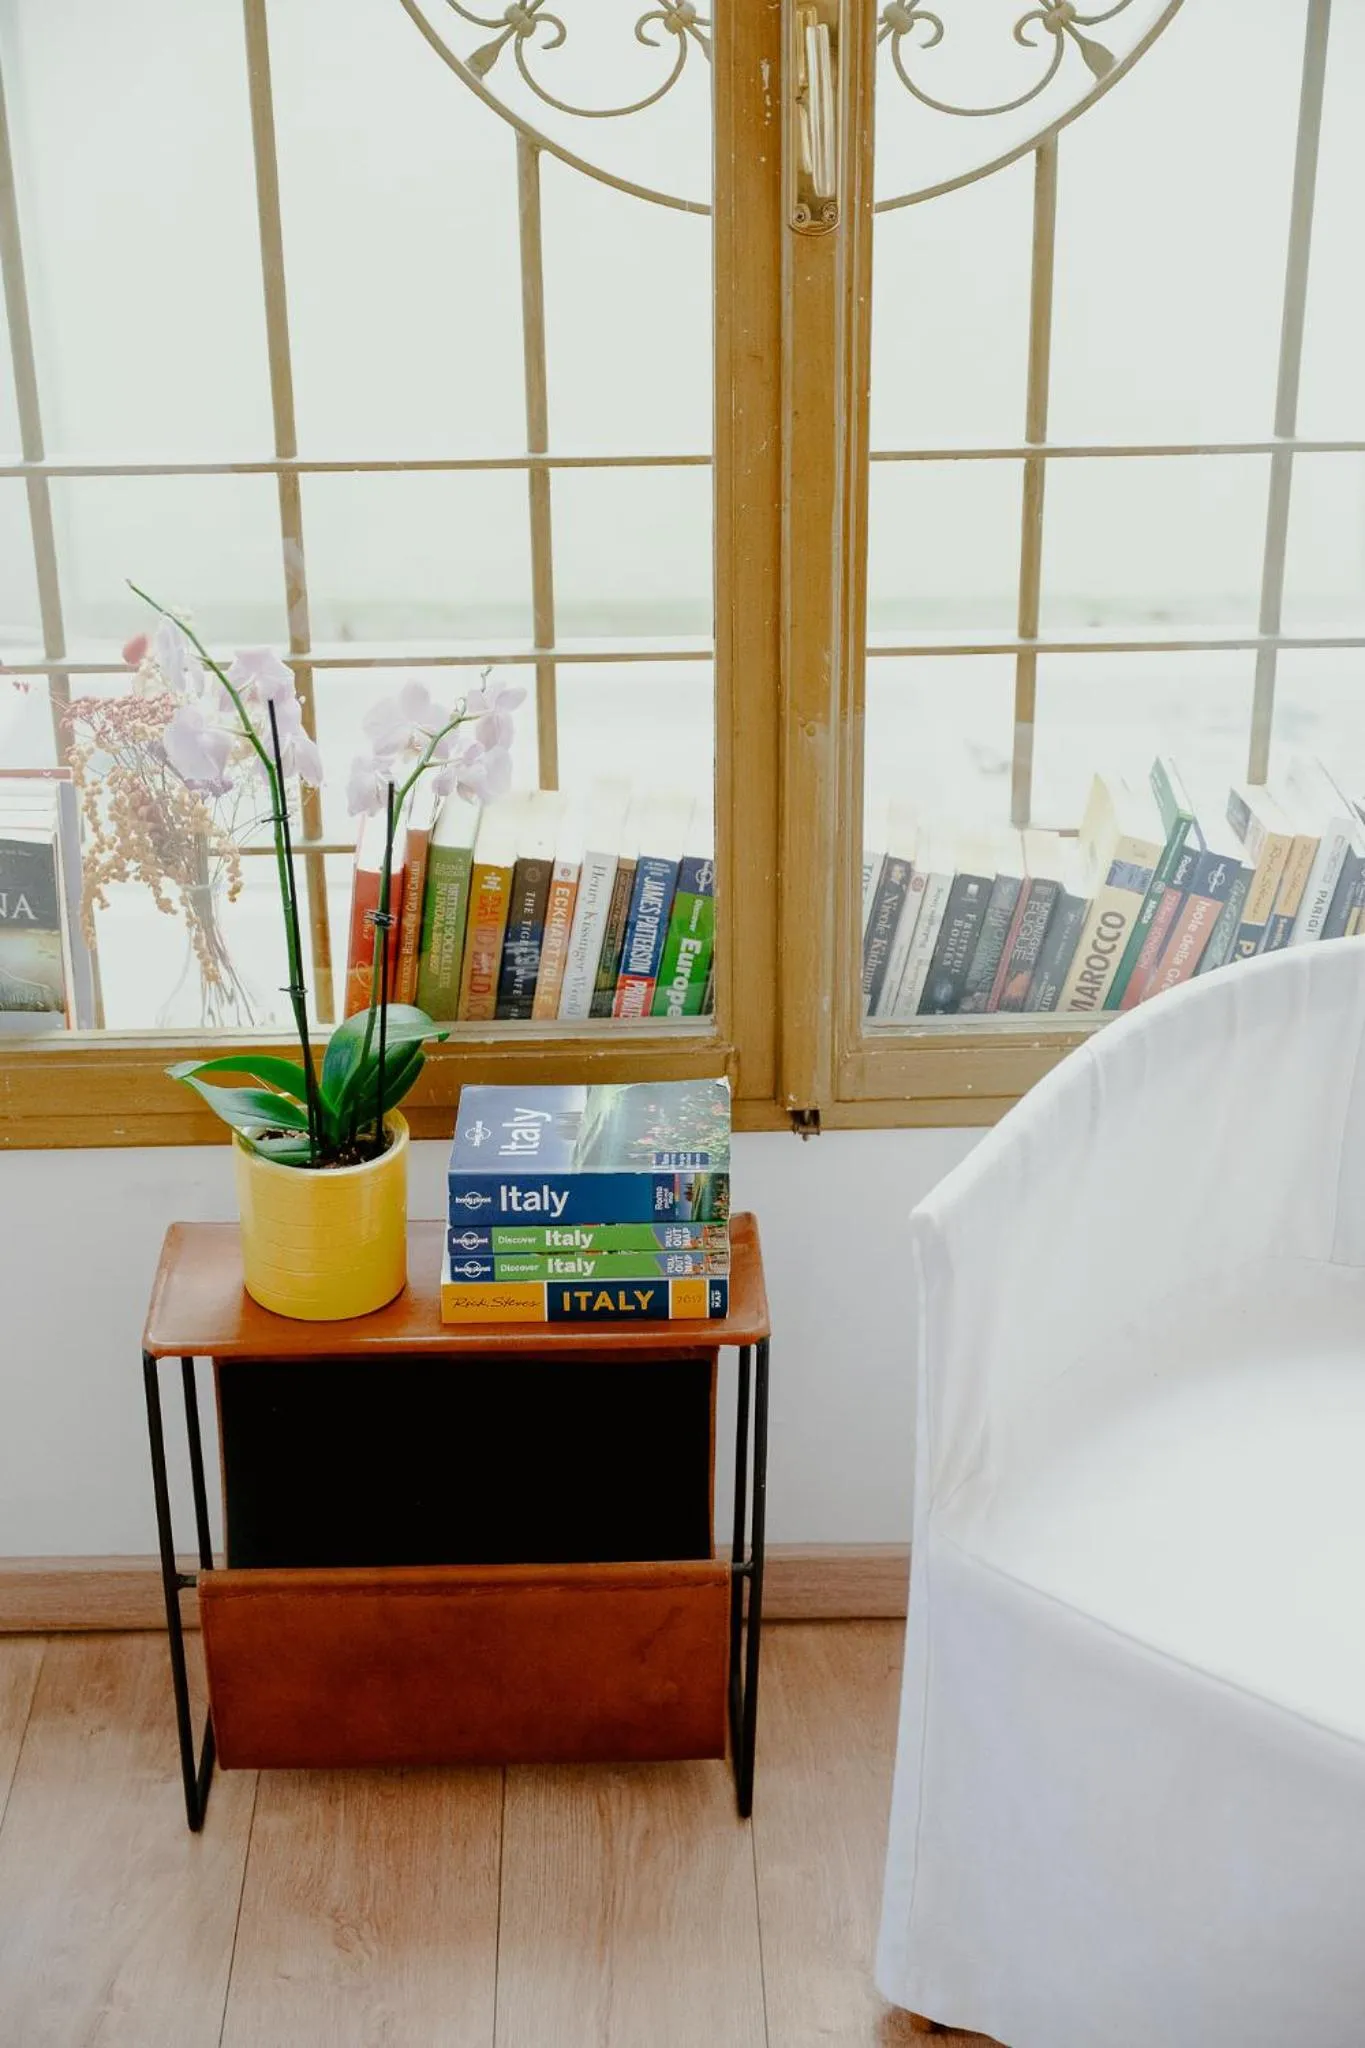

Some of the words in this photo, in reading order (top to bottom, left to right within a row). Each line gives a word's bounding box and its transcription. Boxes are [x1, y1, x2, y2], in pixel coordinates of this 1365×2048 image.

[524, 891, 536, 914] THE
[582, 865, 607, 907] Henry
[639, 877, 666, 914] JAMES
[548, 887, 570, 953] ECKHART
[876, 894, 899, 934] Nicole
[1012, 900, 1036, 961] FUGUE
[1021, 901, 1051, 962] MIDNIGHT
[1187, 900, 1212, 932] Isole
[1305, 889, 1329, 934] PARIGI
[572, 908, 599, 971] Kissinger
[628, 914, 661, 974] PATTERSON
[942, 918, 964, 966] BODIES
[951, 912, 977, 975] FRUITFUL
[1172, 934, 1193, 966] della
[540, 953, 559, 1001] TOLLE
[665, 938, 704, 1017] Europe
[862, 937, 889, 994] Kidman
[567, 973, 587, 1017] World
[498, 1107, 552, 1156] Italy
[500, 1185, 569, 1217] Italy
[497, 1235, 537, 1245] Discover
[545, 1229, 594, 1249] Italy
[673, 1227, 683, 1247] OUT
[500, 1263, 539, 1272] Discover
[547, 1257, 596, 1276] Italy
[675, 1255, 684, 1272] OUT
[563, 1290, 654, 1311] ITALY
